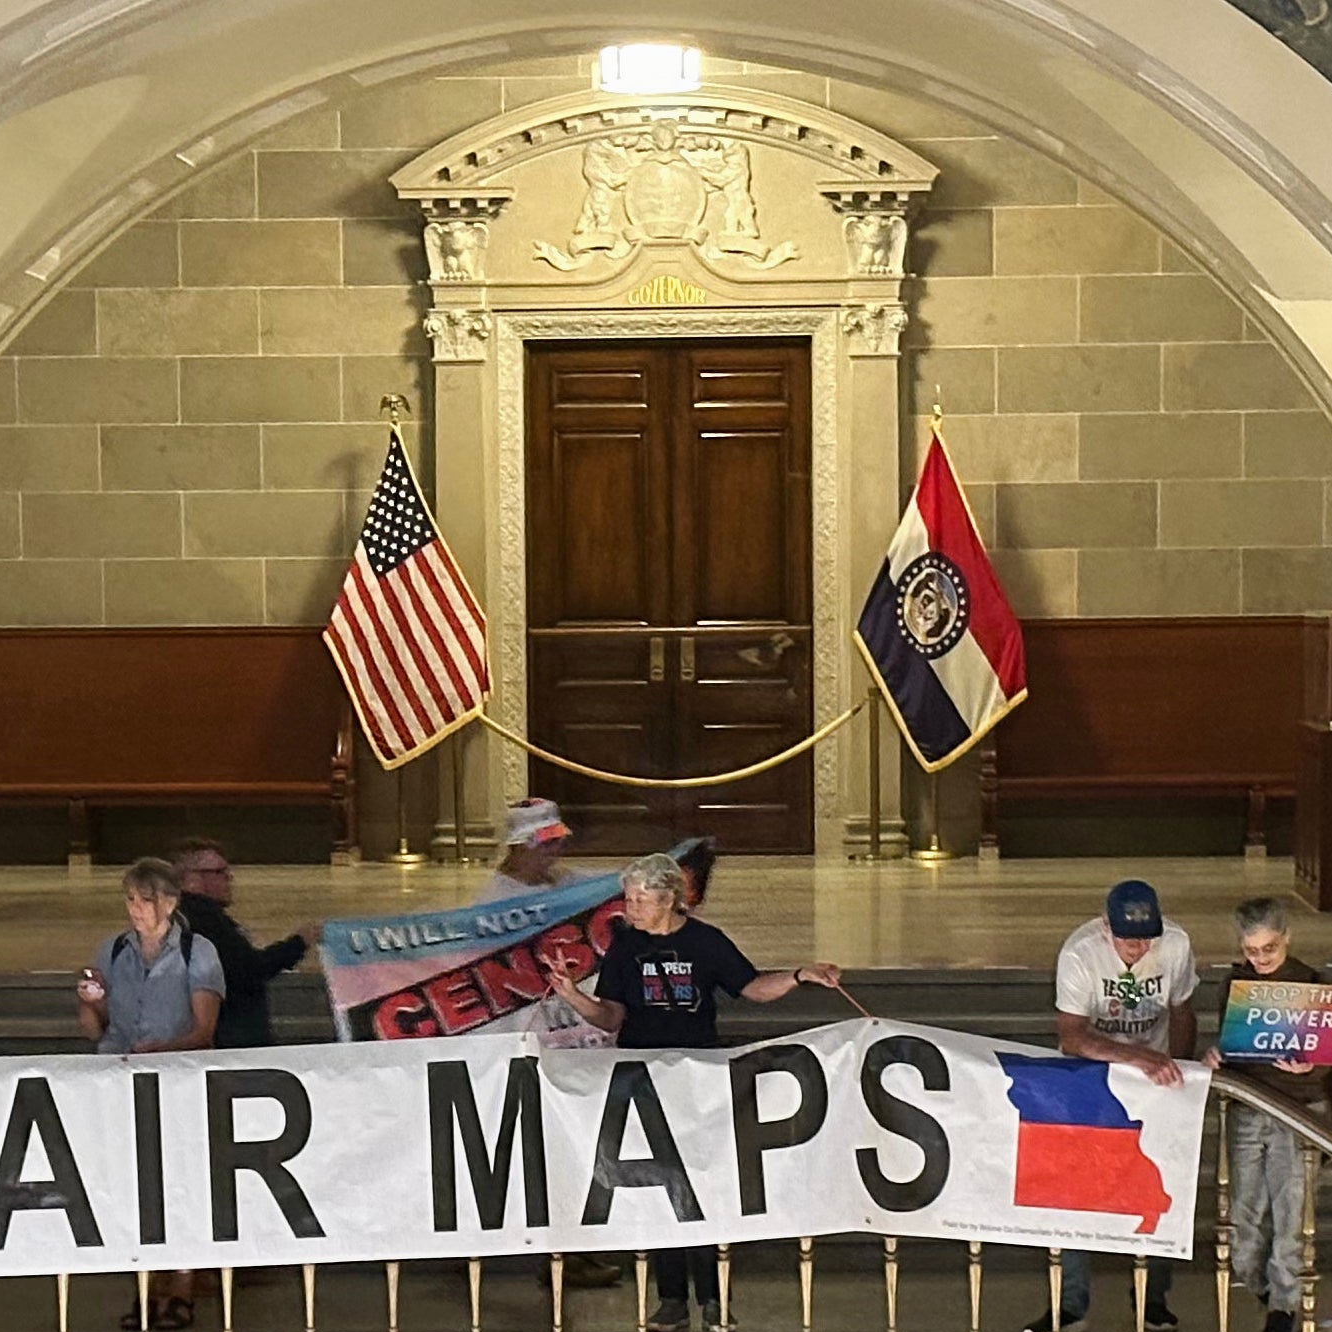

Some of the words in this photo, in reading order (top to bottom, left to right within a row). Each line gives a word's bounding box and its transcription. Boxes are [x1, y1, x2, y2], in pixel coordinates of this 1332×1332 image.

[628, 275, 706, 305] GOVERNOR
[371, 923, 467, 951] WILL
[475, 903, 549, 938] NOT
[1249, 986, 1301, 1001] STOP
[1253, 1031, 1320, 1052] GRAB
[427, 1035, 951, 1232] MAPS
